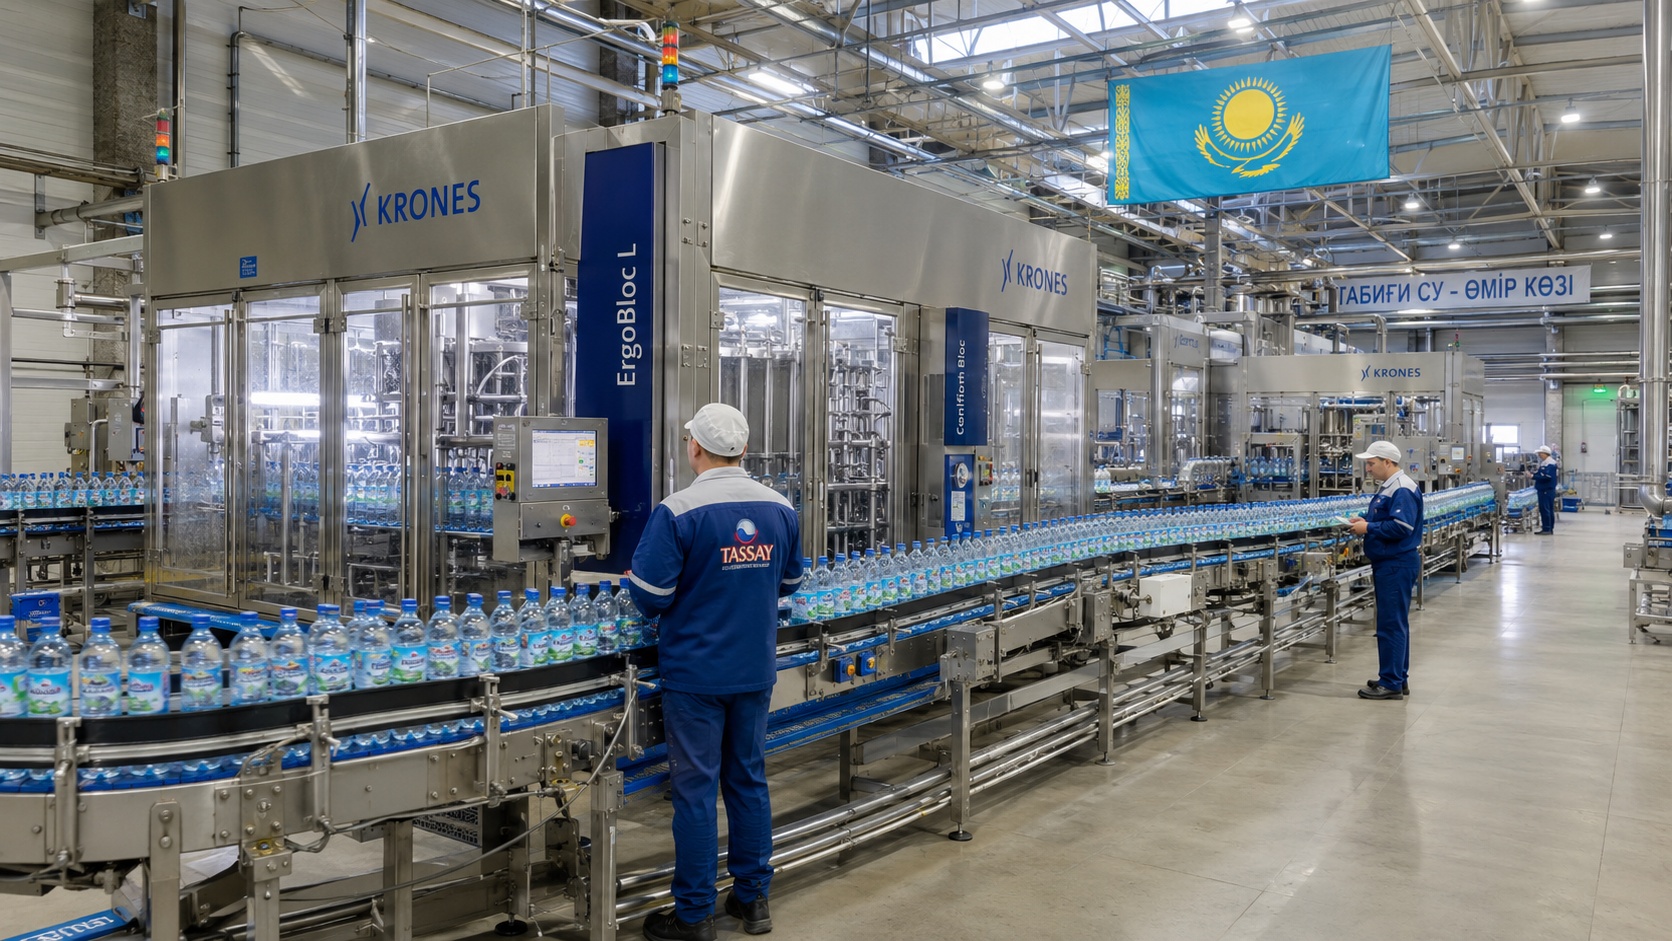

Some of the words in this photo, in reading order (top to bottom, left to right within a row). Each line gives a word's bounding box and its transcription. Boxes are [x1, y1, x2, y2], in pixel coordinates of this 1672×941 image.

[378, 179, 481, 225] KRONES
[617, 243, 637, 258] L
[1017, 262, 1068, 296] KRONES
[1417, 281, 1444, 302] СУ
[1524, 274, 1573, 298] КӨЗІ
[616, 266, 643, 386] ErgoBloc
[957, 339, 966, 368] Bloc
[1373, 367, 1421, 378] KRONES
[720, 544, 774, 564] TASSAY
